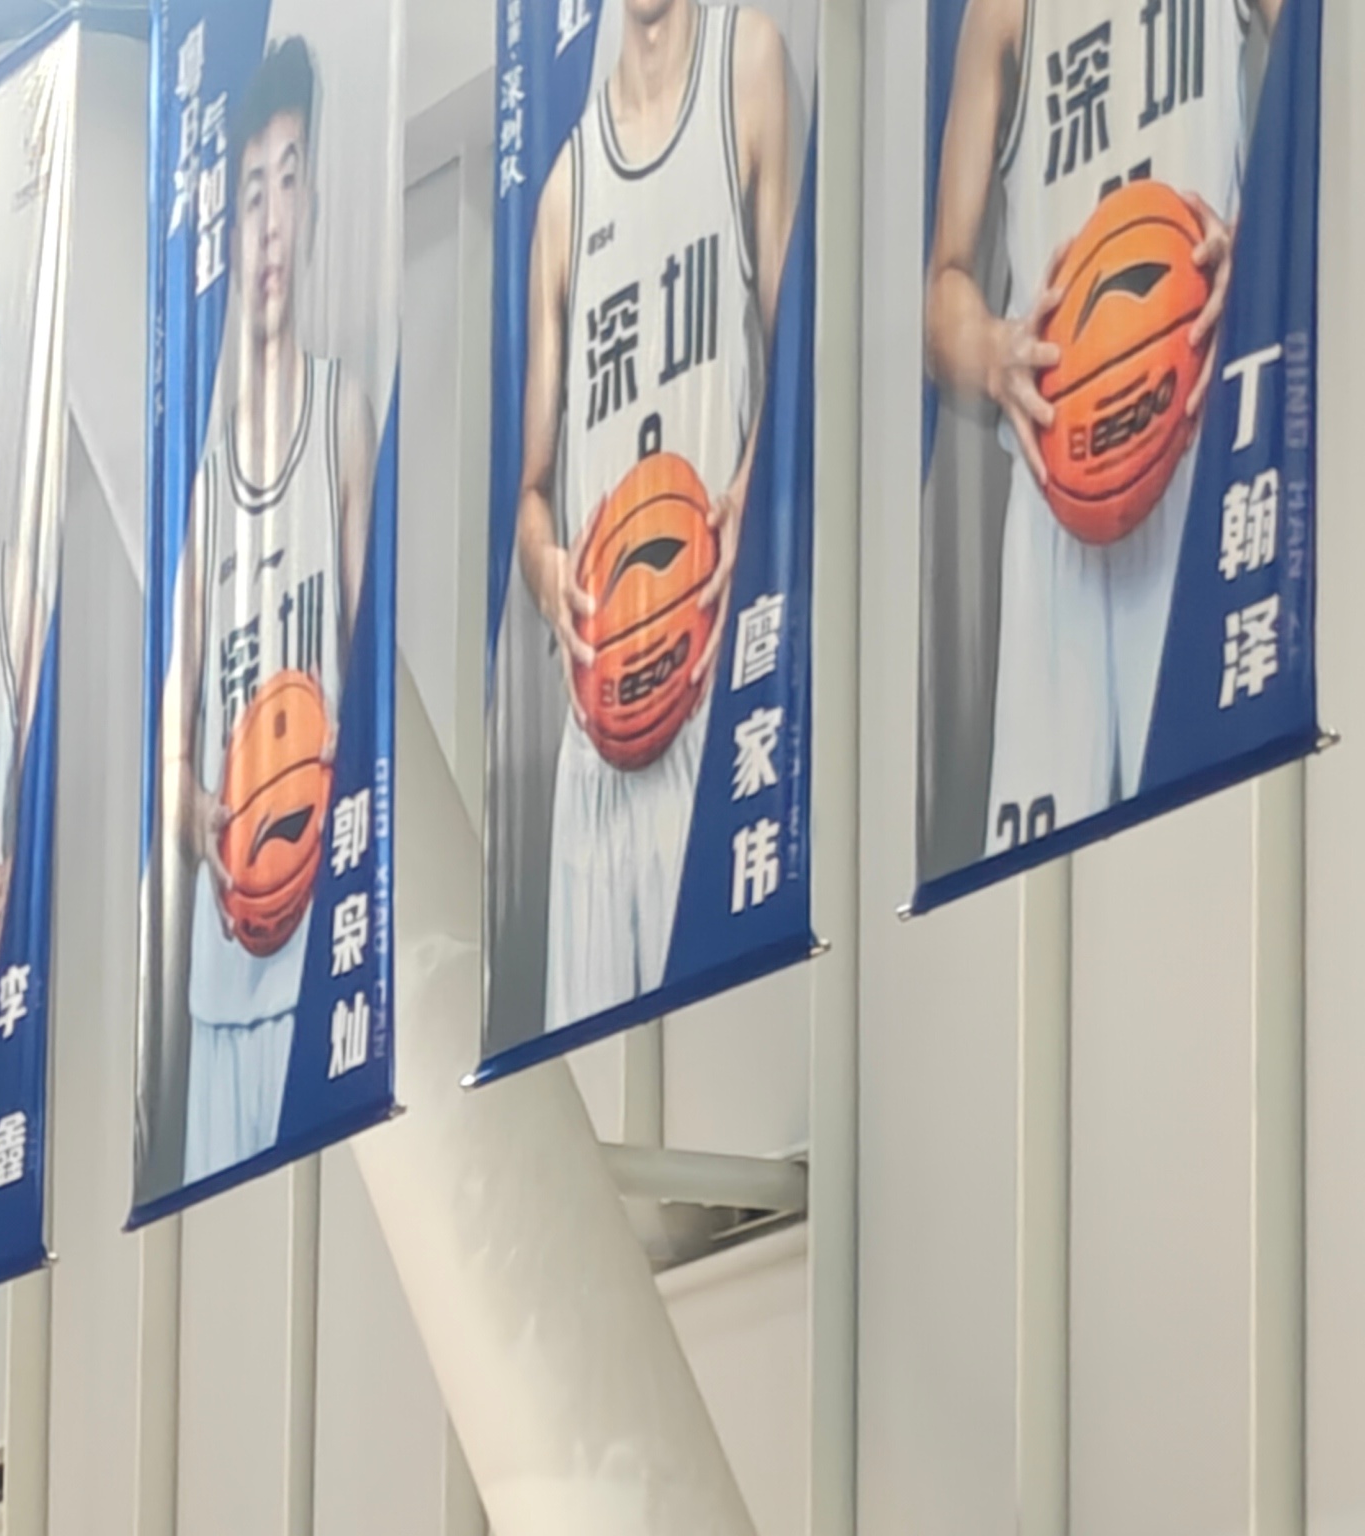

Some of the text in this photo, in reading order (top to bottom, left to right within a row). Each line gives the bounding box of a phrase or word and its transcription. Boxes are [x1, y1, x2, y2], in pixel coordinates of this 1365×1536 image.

[1044, 0, 1205, 187] 深圳
[586, 232, 719, 431] 深圳
[1218, 342, 1283, 709] 丁翰泽
[220, 569, 325, 750] 深圳
[730, 592, 787, 916] 廖家伟
[327, 786, 371, 1081] 郭枭灿
